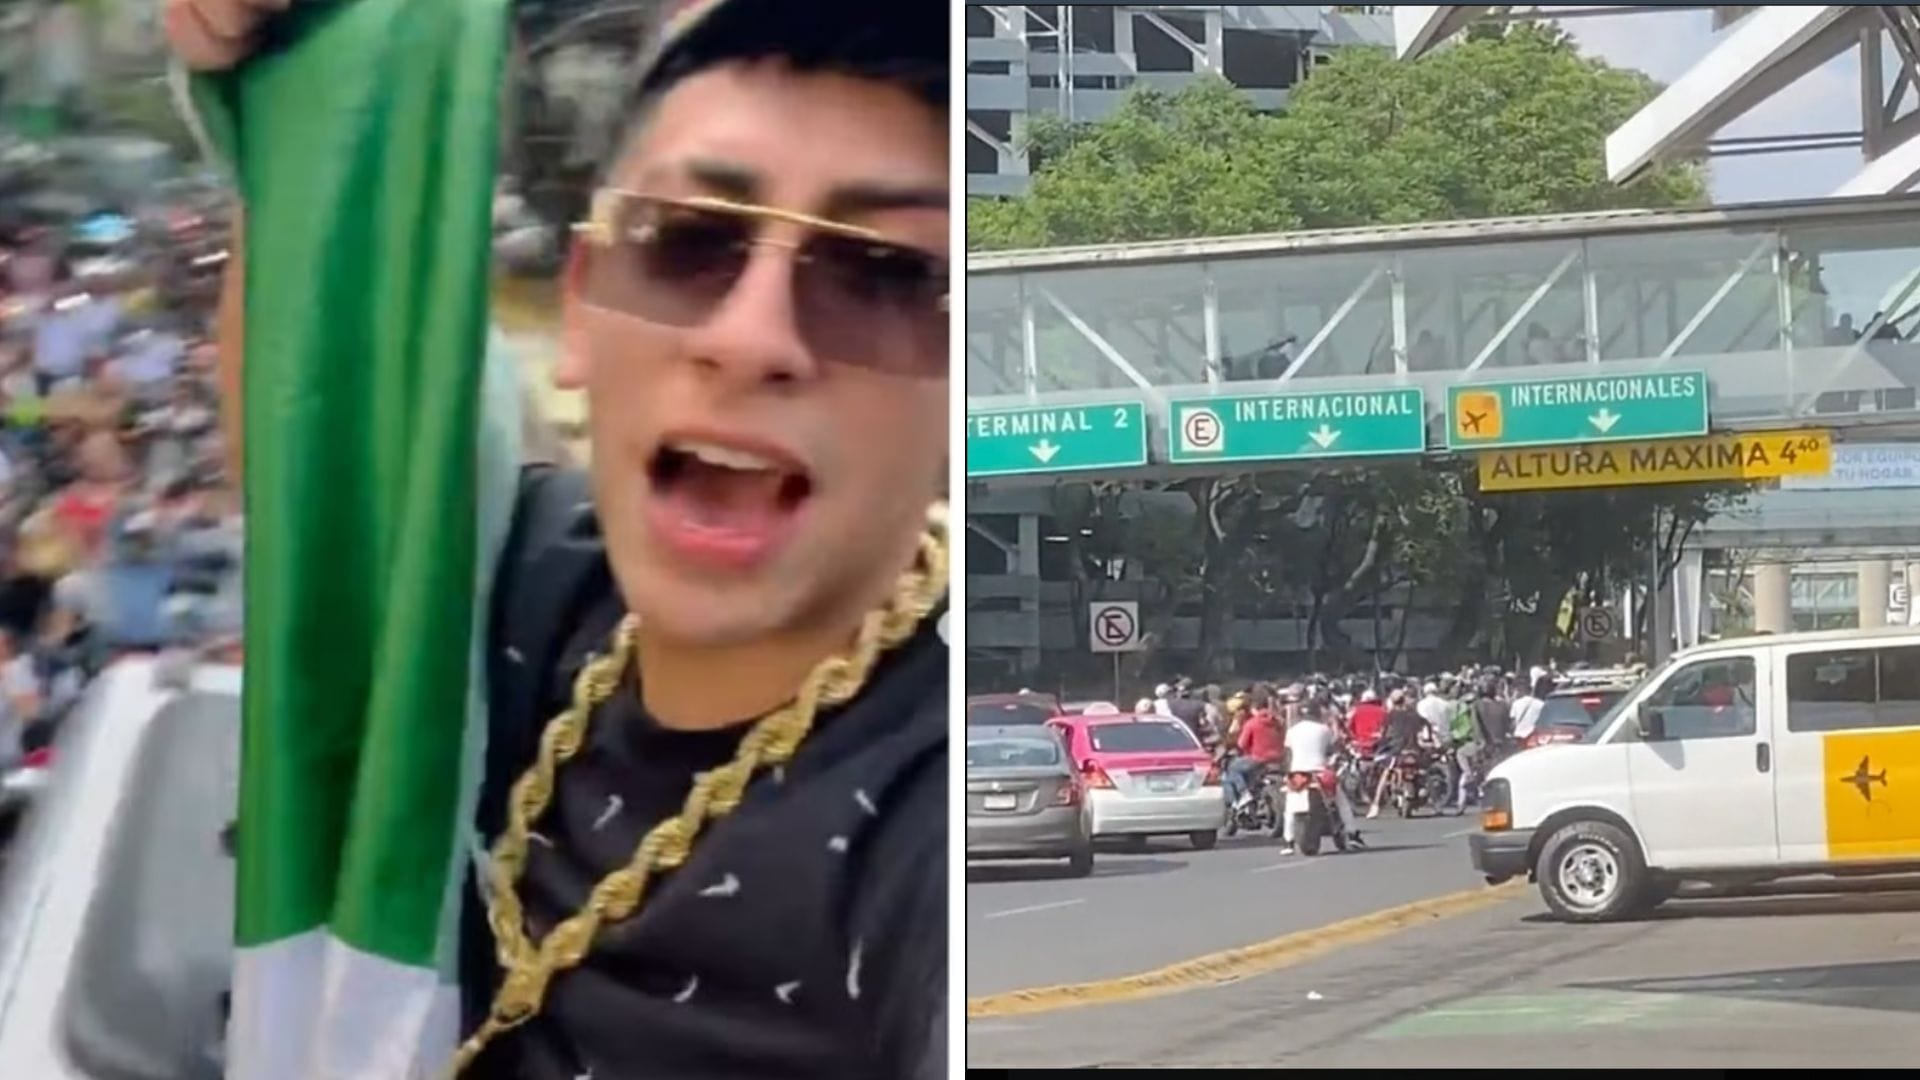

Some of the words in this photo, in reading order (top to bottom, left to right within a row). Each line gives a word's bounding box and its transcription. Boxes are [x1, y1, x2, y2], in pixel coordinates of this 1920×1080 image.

[1511, 376, 1696, 408] INTERNACIONALES
[1113, 406, 1128, 428] 2
[1235, 393, 1412, 422] INTERNACIONAL
[1491, 444, 1619, 480] ALTURA
[1630, 437, 1770, 473] MAXIMA
